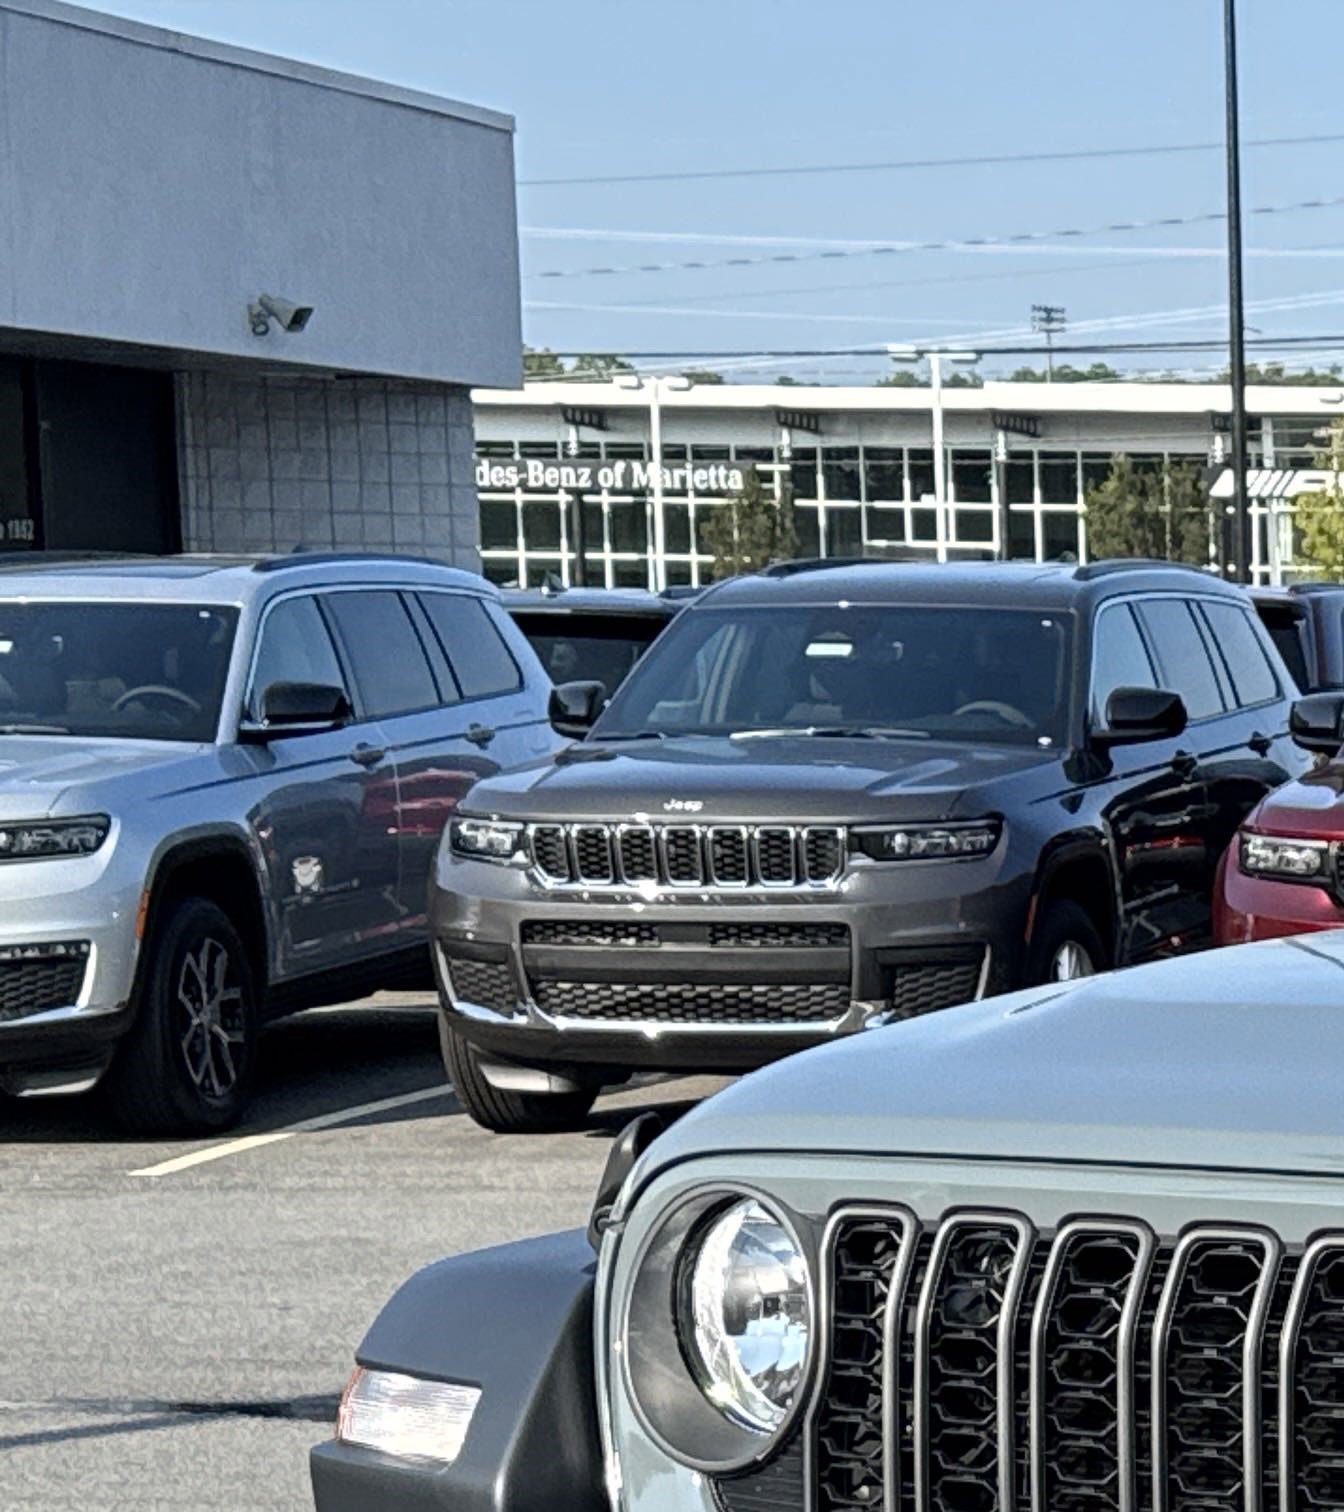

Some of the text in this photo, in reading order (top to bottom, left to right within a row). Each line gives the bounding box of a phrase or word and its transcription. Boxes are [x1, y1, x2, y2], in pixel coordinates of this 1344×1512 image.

[475, 460, 744, 491] des-Benz of Marietta
